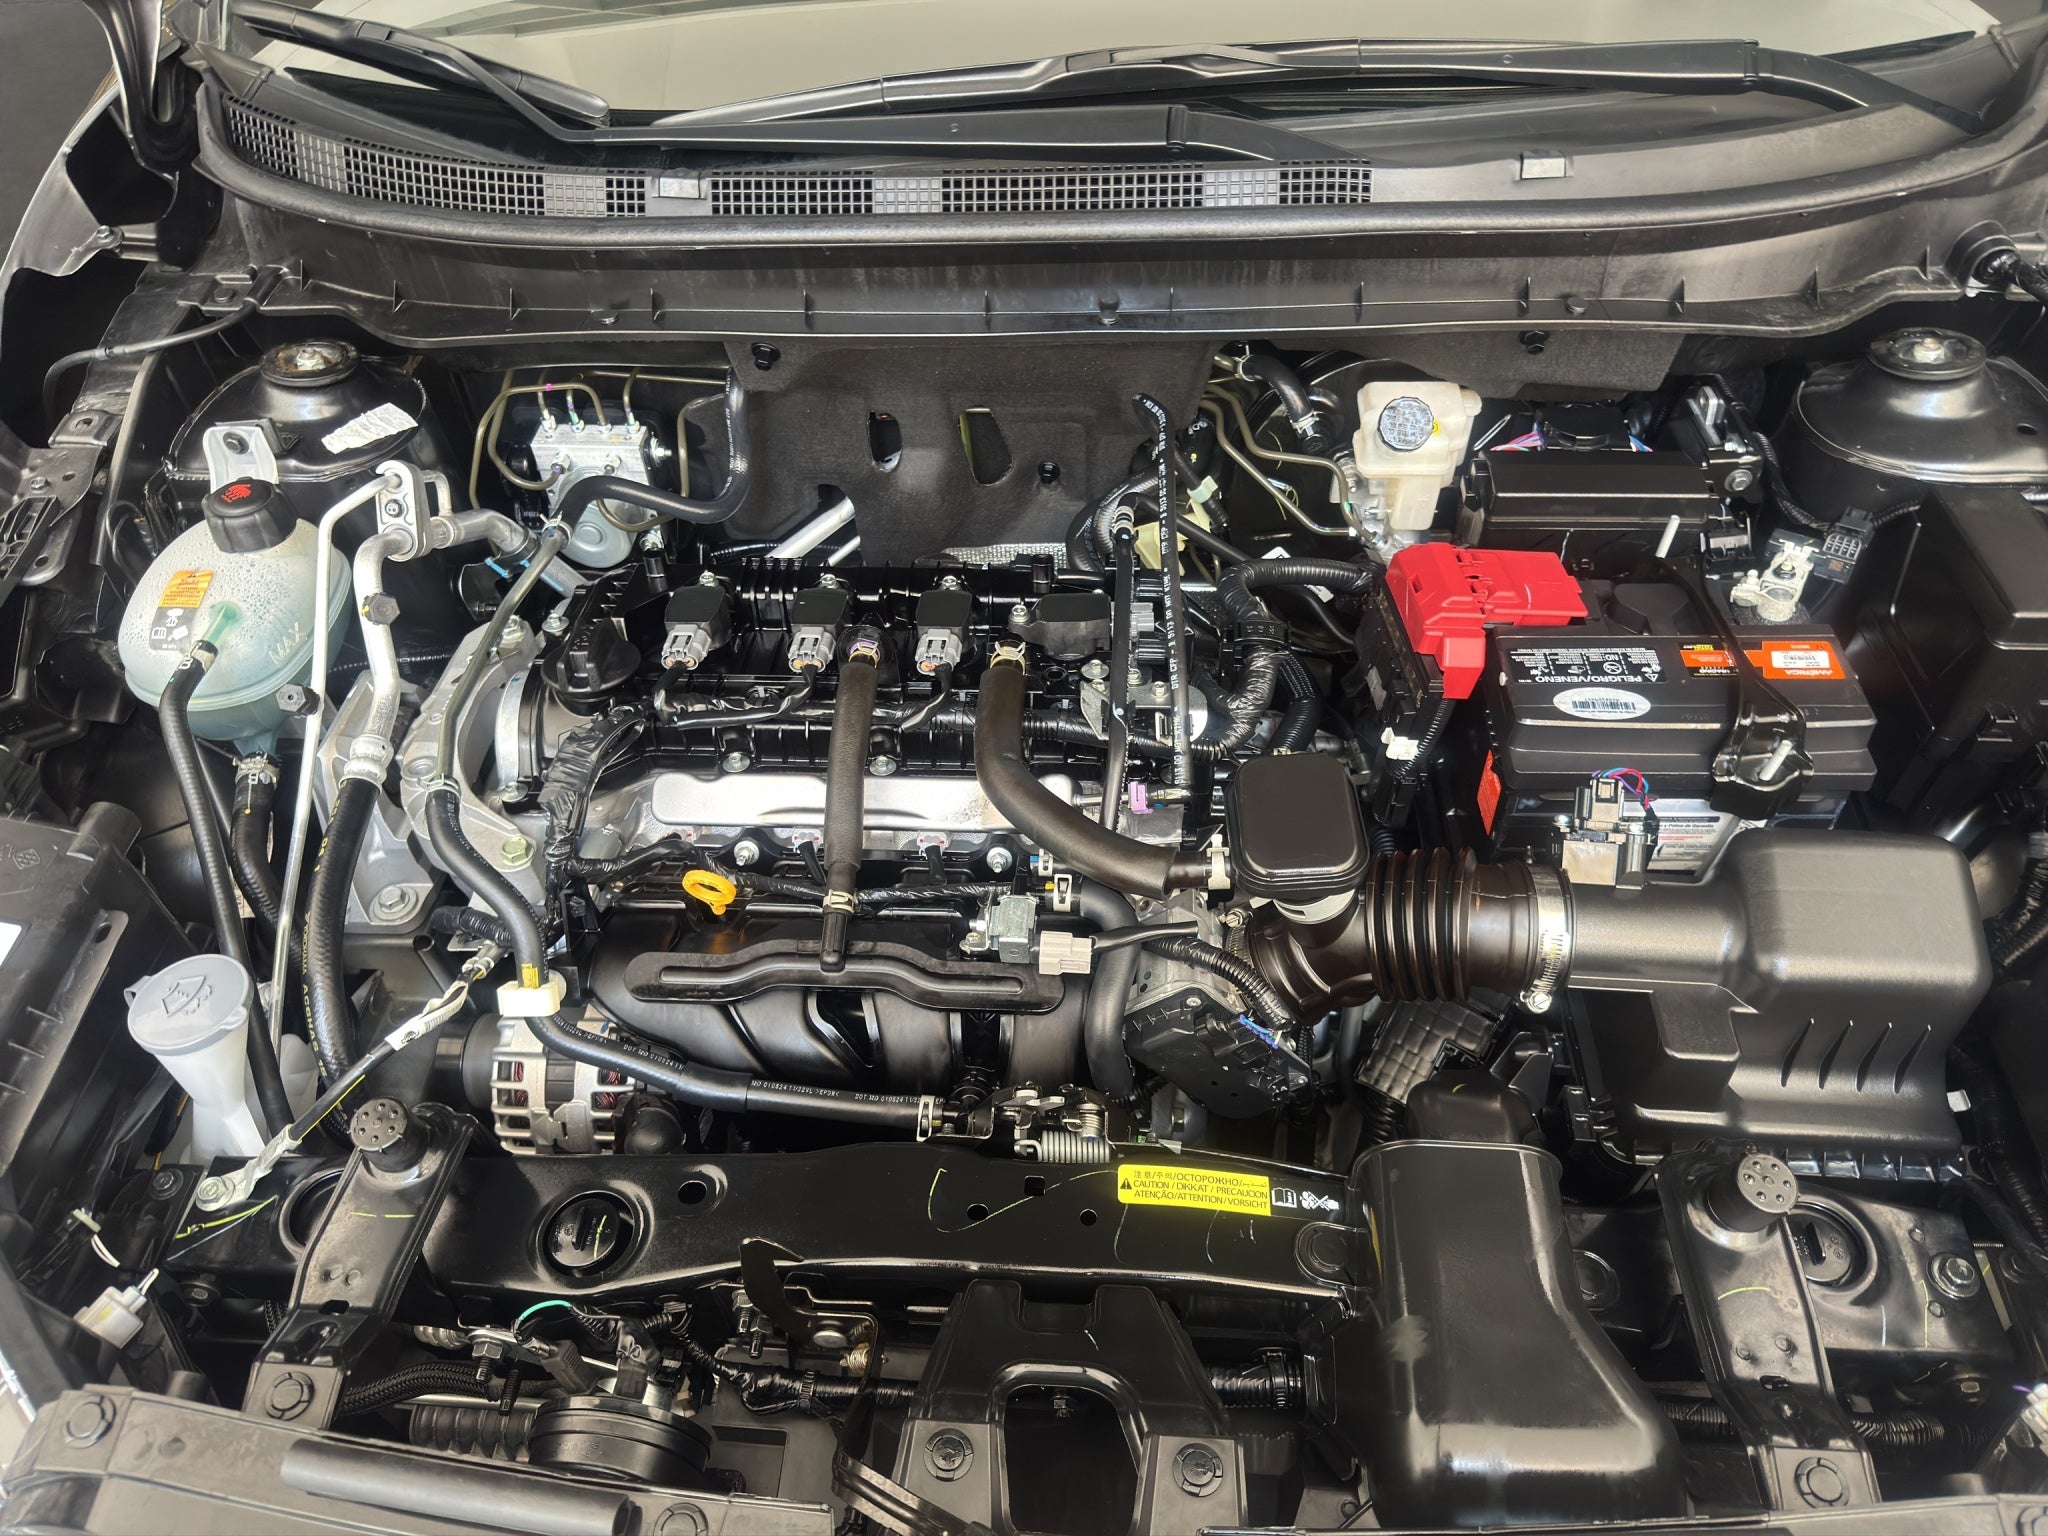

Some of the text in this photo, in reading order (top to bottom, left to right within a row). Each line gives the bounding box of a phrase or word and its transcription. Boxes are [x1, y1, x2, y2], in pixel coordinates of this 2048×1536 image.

[268, 621, 306, 665] MAX
[1535, 675, 1642, 683] PELIGRO/VENENO
[1134, 1180, 1170, 1190] CAUTION
[1216, 1187, 1268, 1199] PRECAUCION
